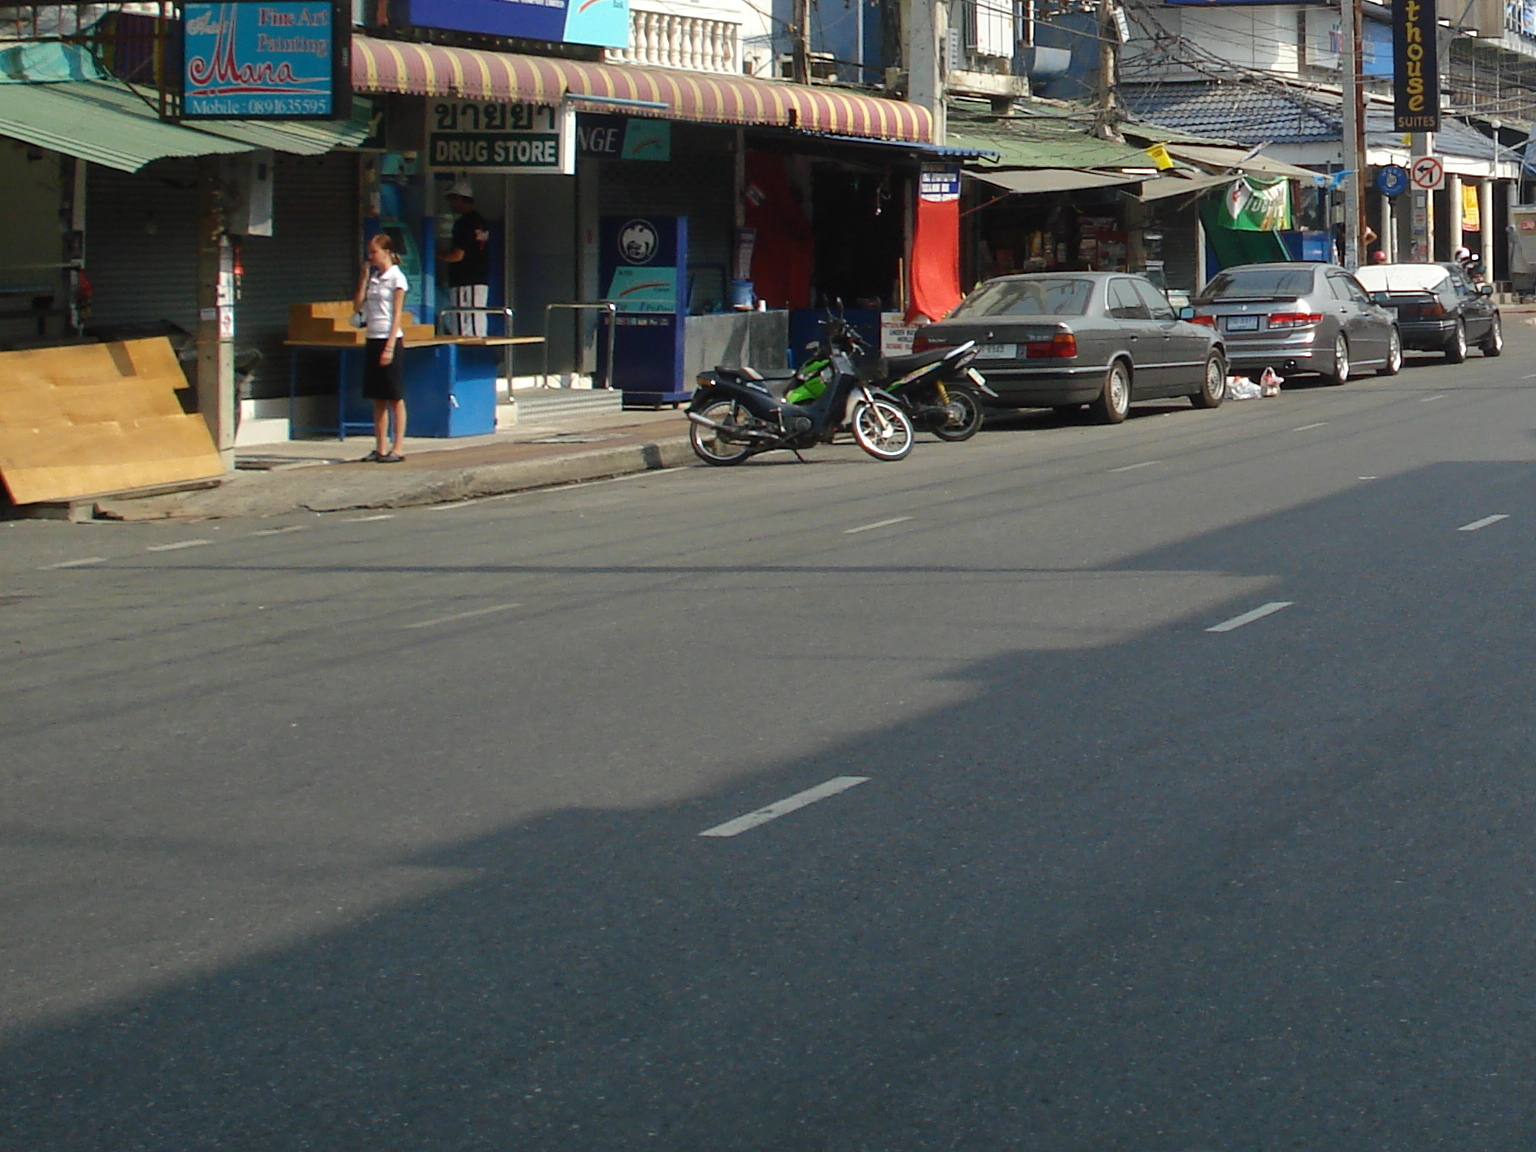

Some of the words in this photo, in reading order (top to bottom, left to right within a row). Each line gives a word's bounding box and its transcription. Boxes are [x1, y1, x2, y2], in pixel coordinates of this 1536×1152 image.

[257, 7, 294, 26] Fine
[297, 7, 329, 26] Art
[187, 3, 305, 85] Mana
[256, 33, 329, 57] Painting
[191, 100, 240, 114] Mobile
[434, 103, 556, 130] ขายยา
[1398, 115, 1436, 128] SUITES
[436, 140, 488, 163] DRUG
[494, 140, 556, 163] STORE
